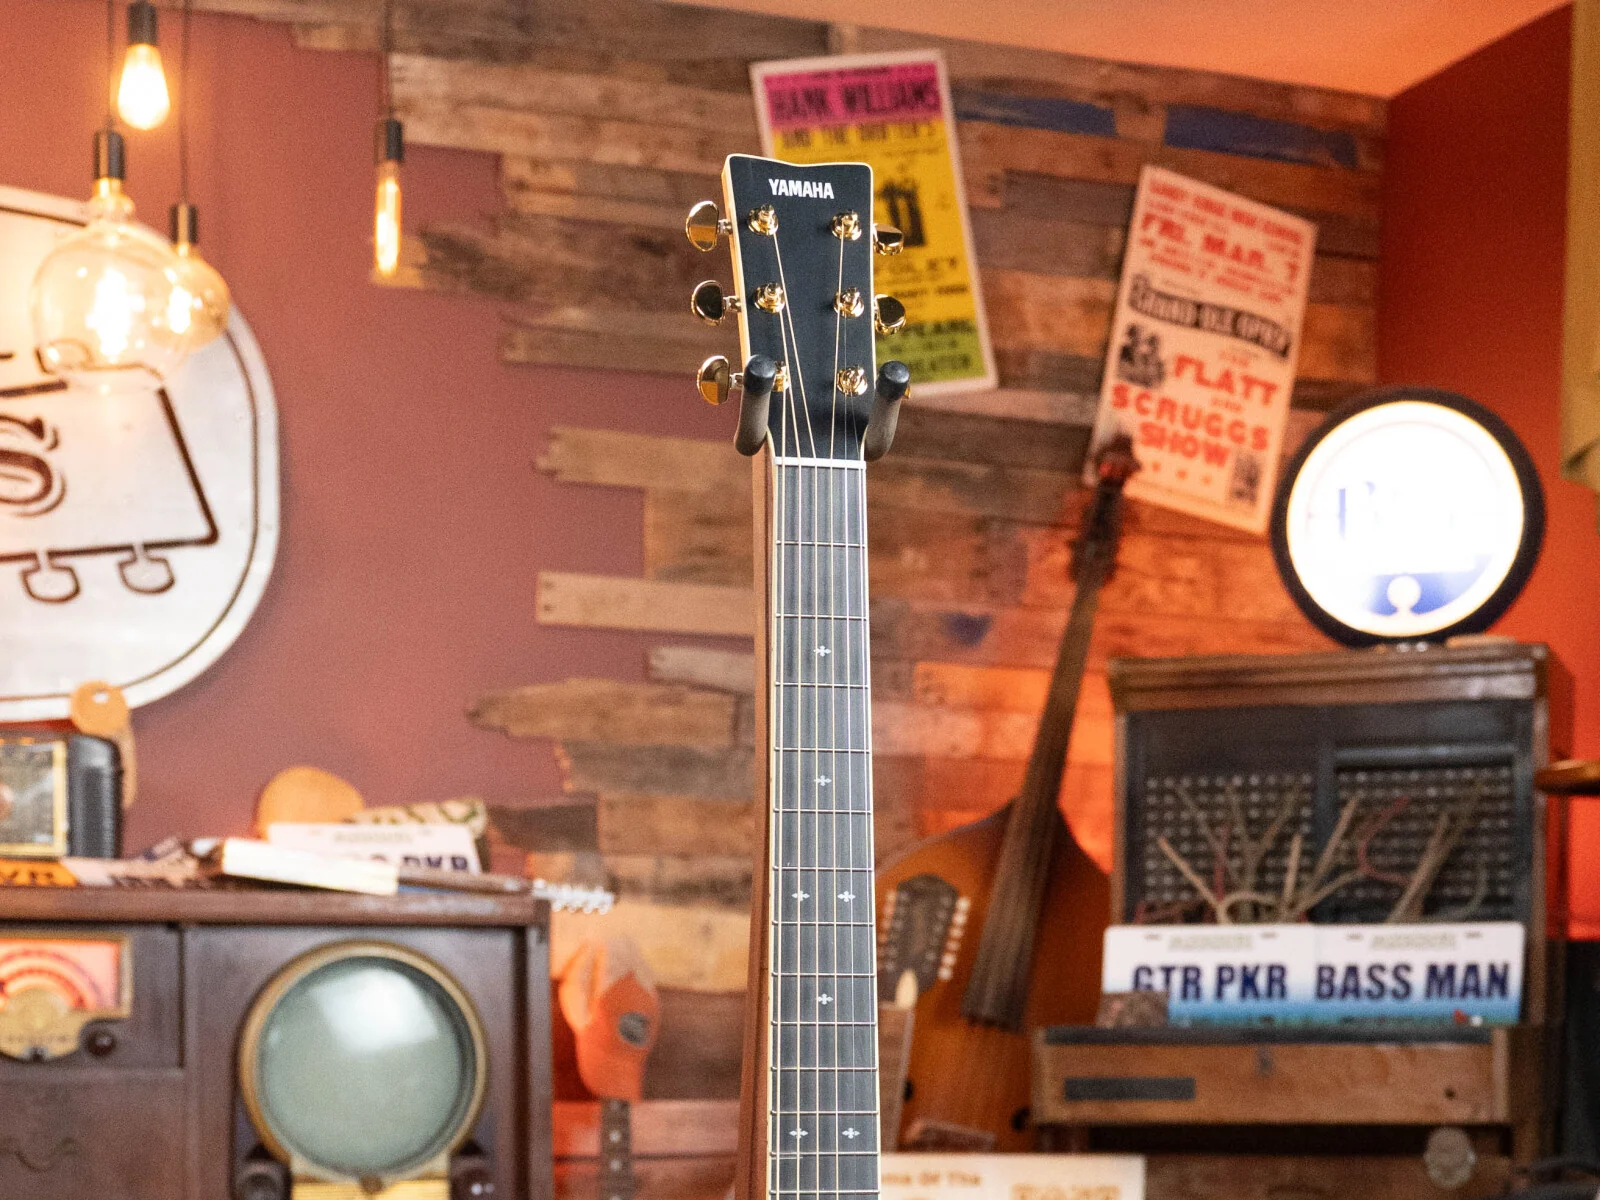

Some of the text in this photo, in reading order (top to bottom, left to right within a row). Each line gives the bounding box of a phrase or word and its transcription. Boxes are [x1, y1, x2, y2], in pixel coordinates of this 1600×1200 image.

[767, 77, 942, 122] HANK WILLIAMS
[768, 178, 835, 199] YAMAHA
[1173, 353, 1278, 407] FLATT
[1111, 383, 1269, 452] SCRUGGS
[1140, 421, 1231, 468] SHOW
[1216, 963, 1287, 1001] PKR
[1315, 962, 1510, 1002] BASS MAN
